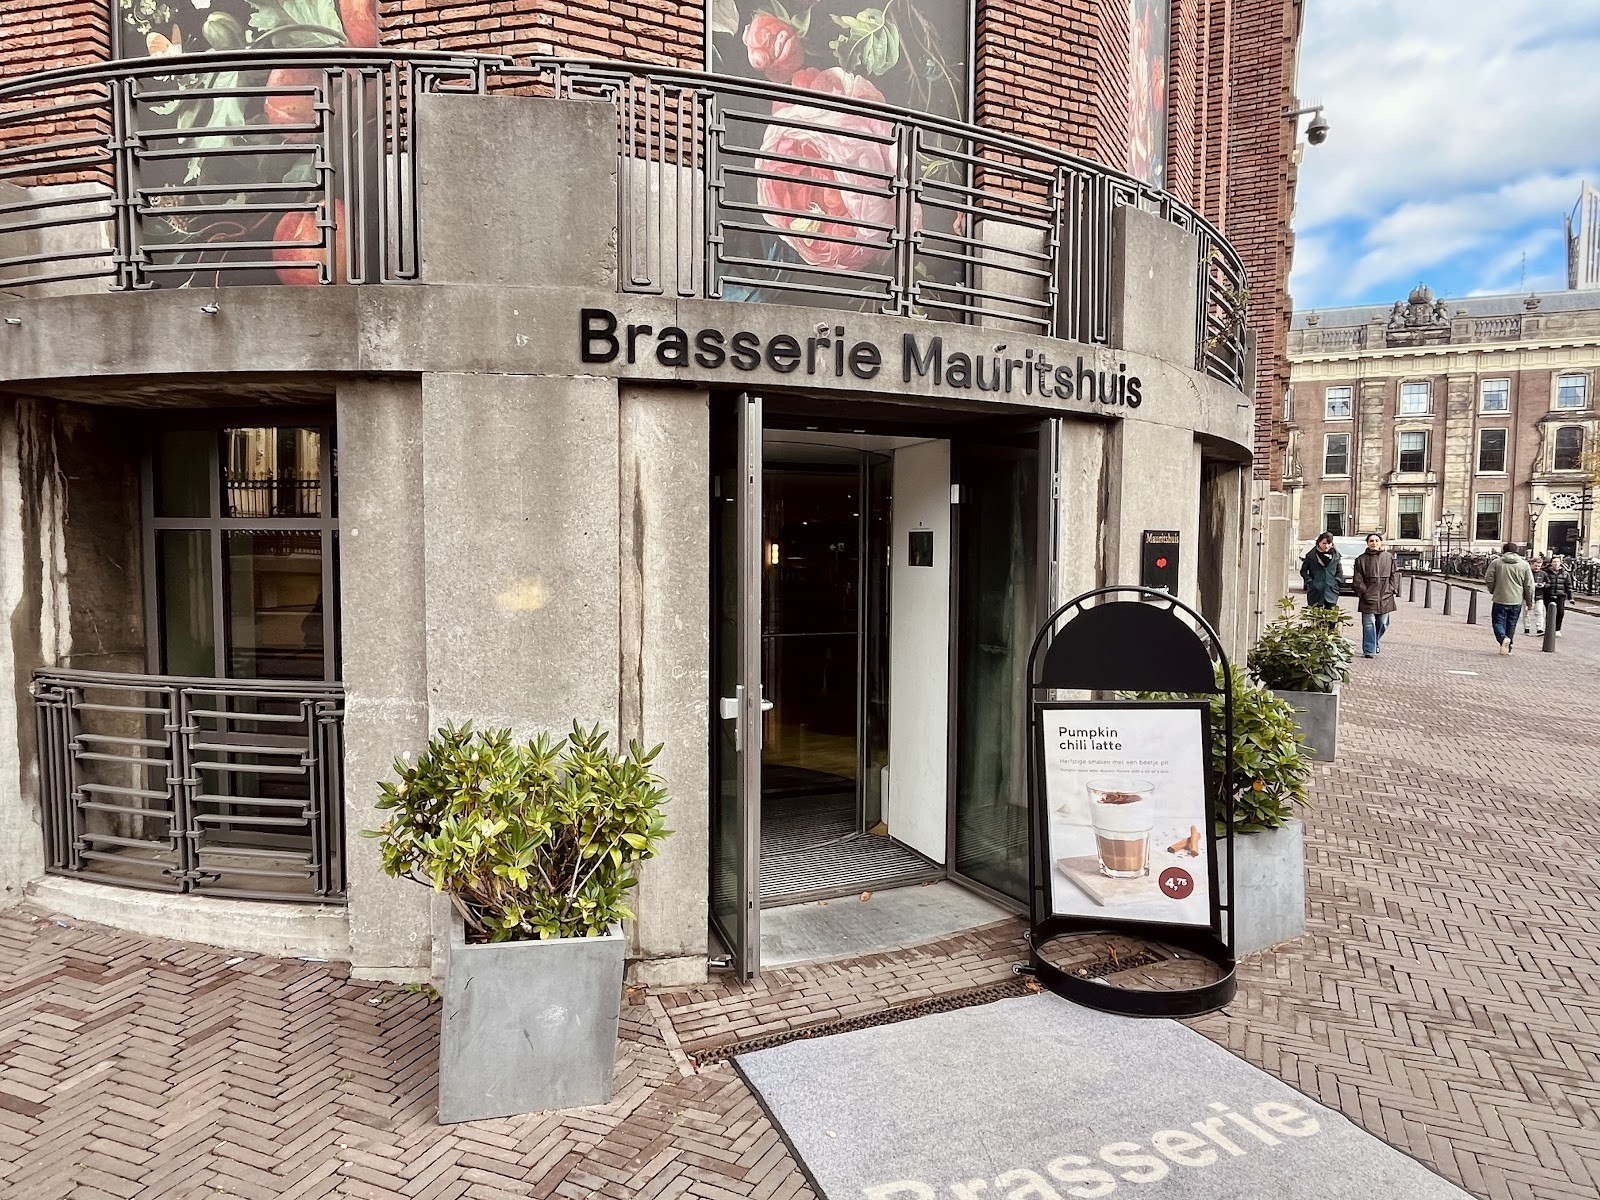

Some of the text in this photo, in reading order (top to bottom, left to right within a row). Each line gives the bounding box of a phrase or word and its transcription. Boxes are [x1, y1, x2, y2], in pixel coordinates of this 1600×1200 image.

[580, 307, 1142, 409] Brasserie Mauritshuis
[1058, 726, 1118, 740] Pumpkin
[1059, 740, 1122, 751] chili latte
[1164, 877, 1188, 891] 4,75
